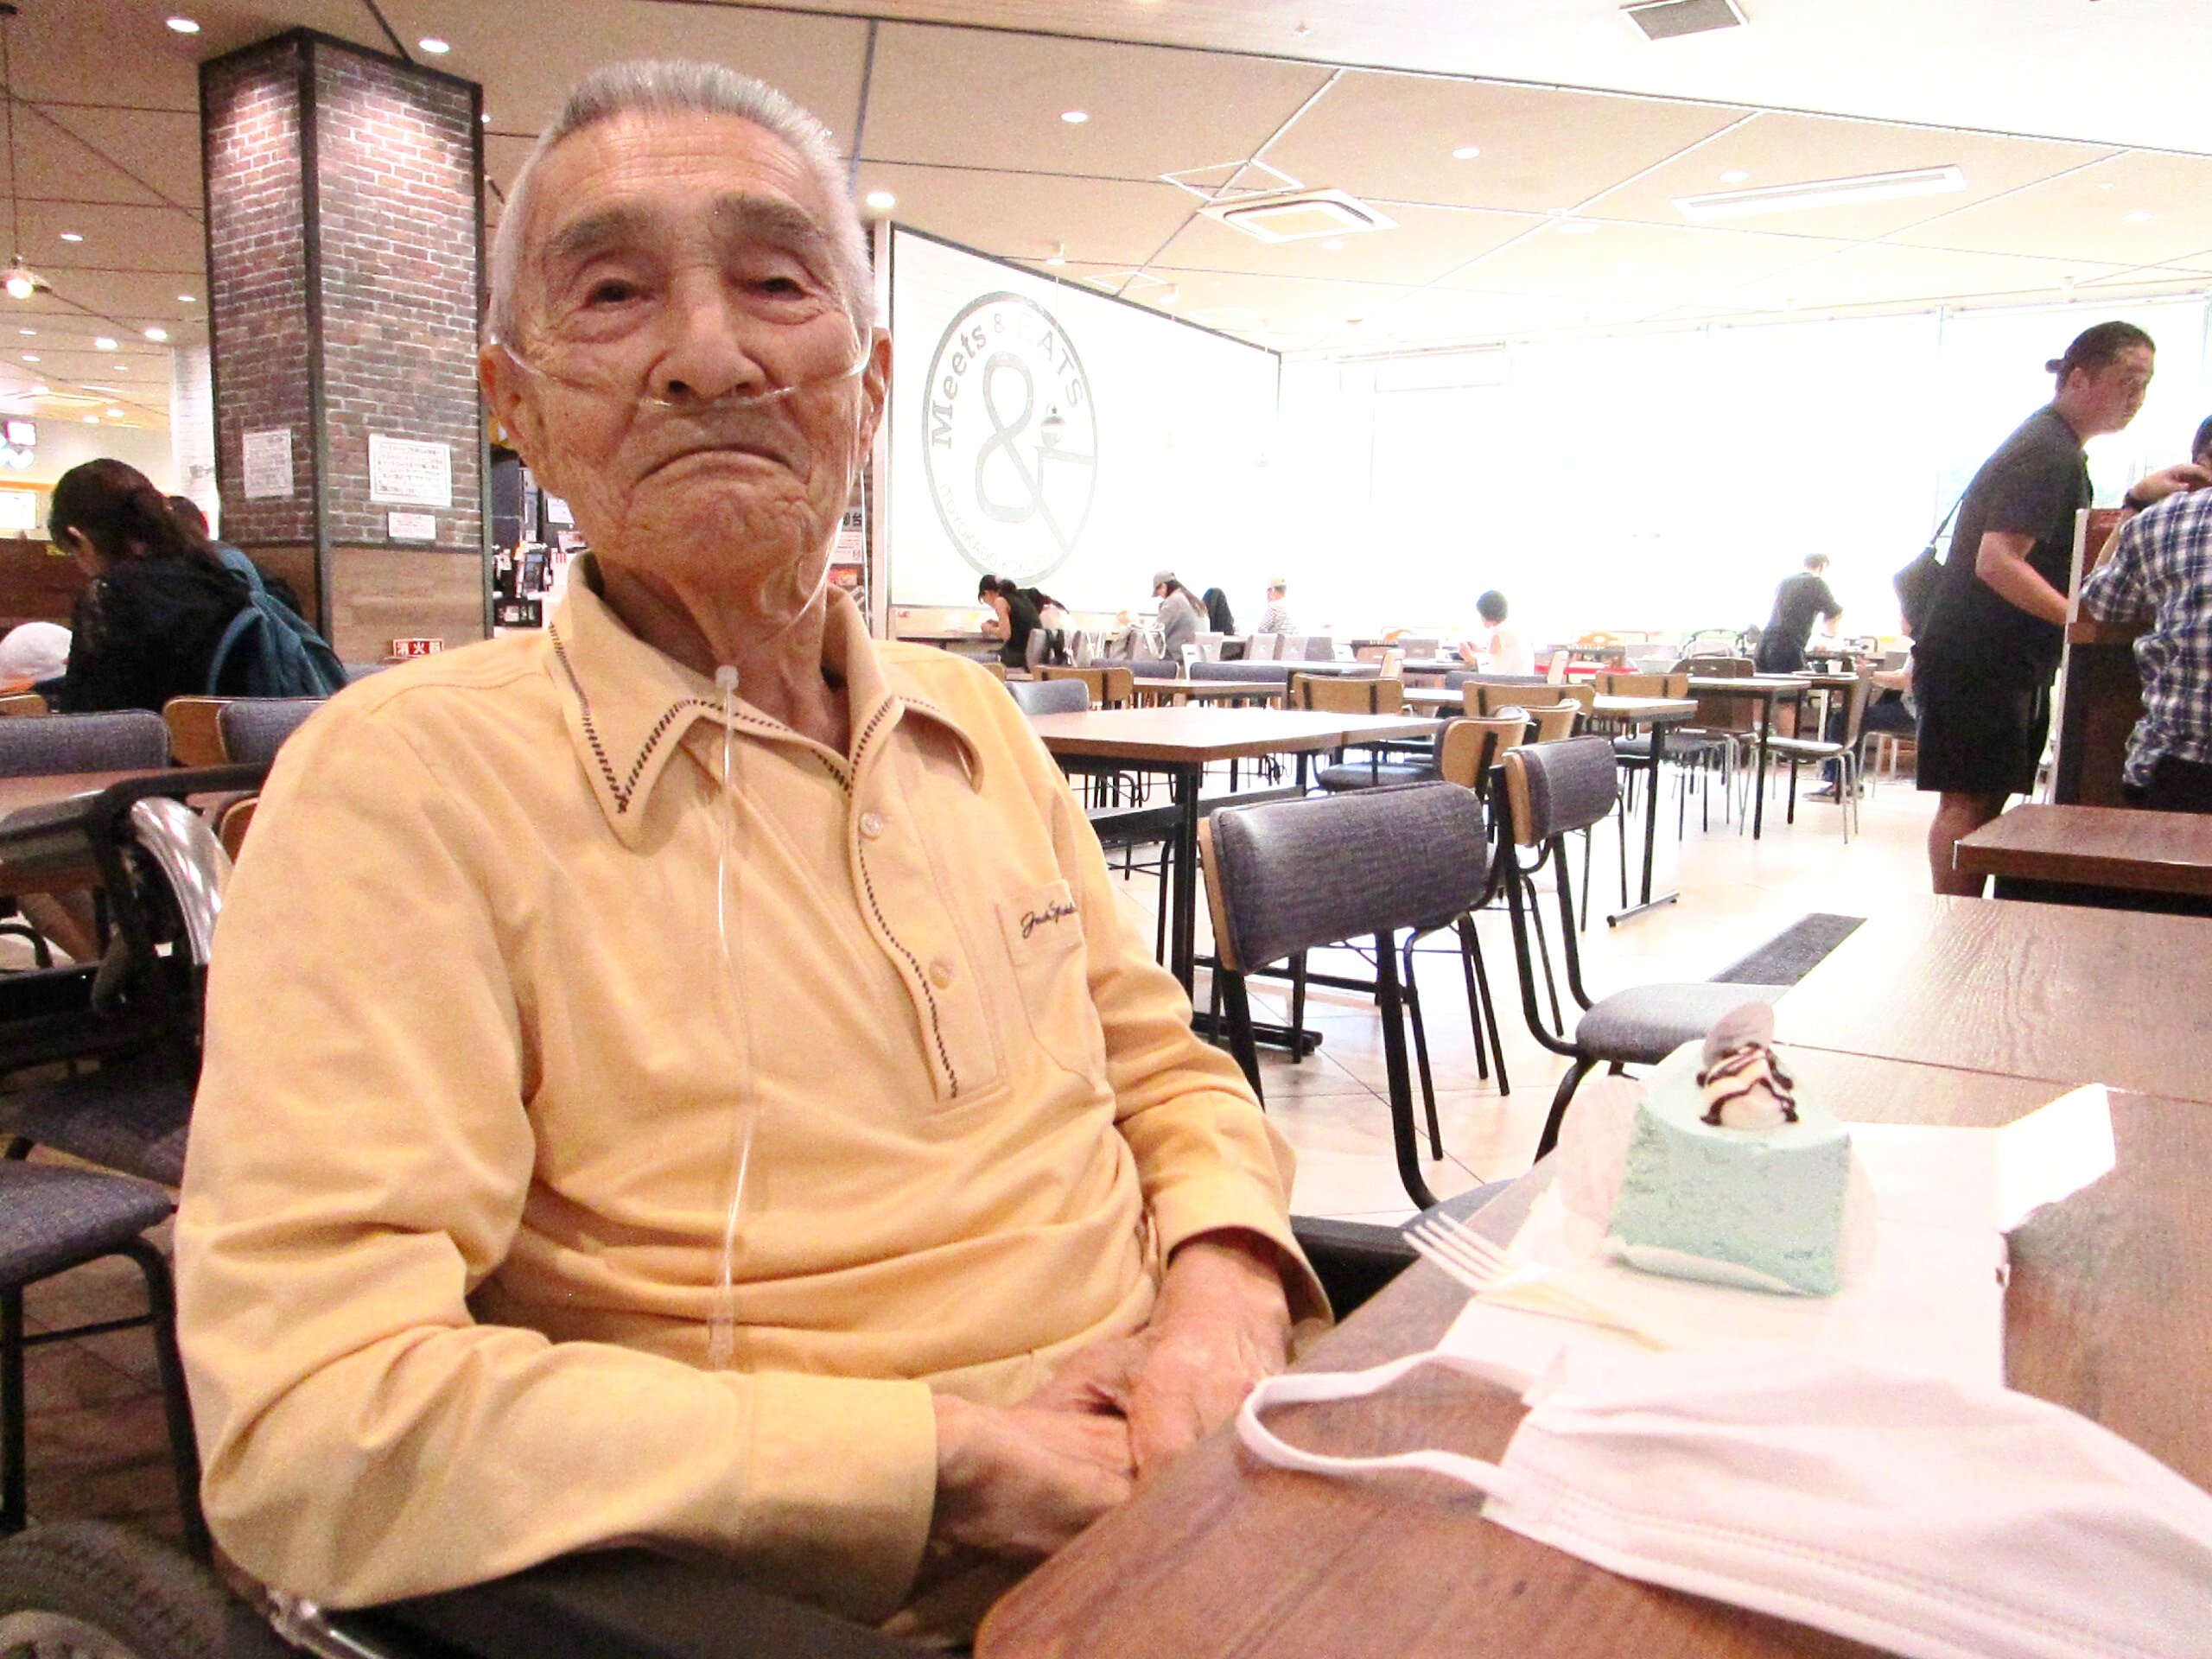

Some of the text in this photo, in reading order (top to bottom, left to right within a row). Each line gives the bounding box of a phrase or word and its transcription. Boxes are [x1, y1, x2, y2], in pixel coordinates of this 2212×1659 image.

[931, 312, 1084, 449] Meets & EATS
